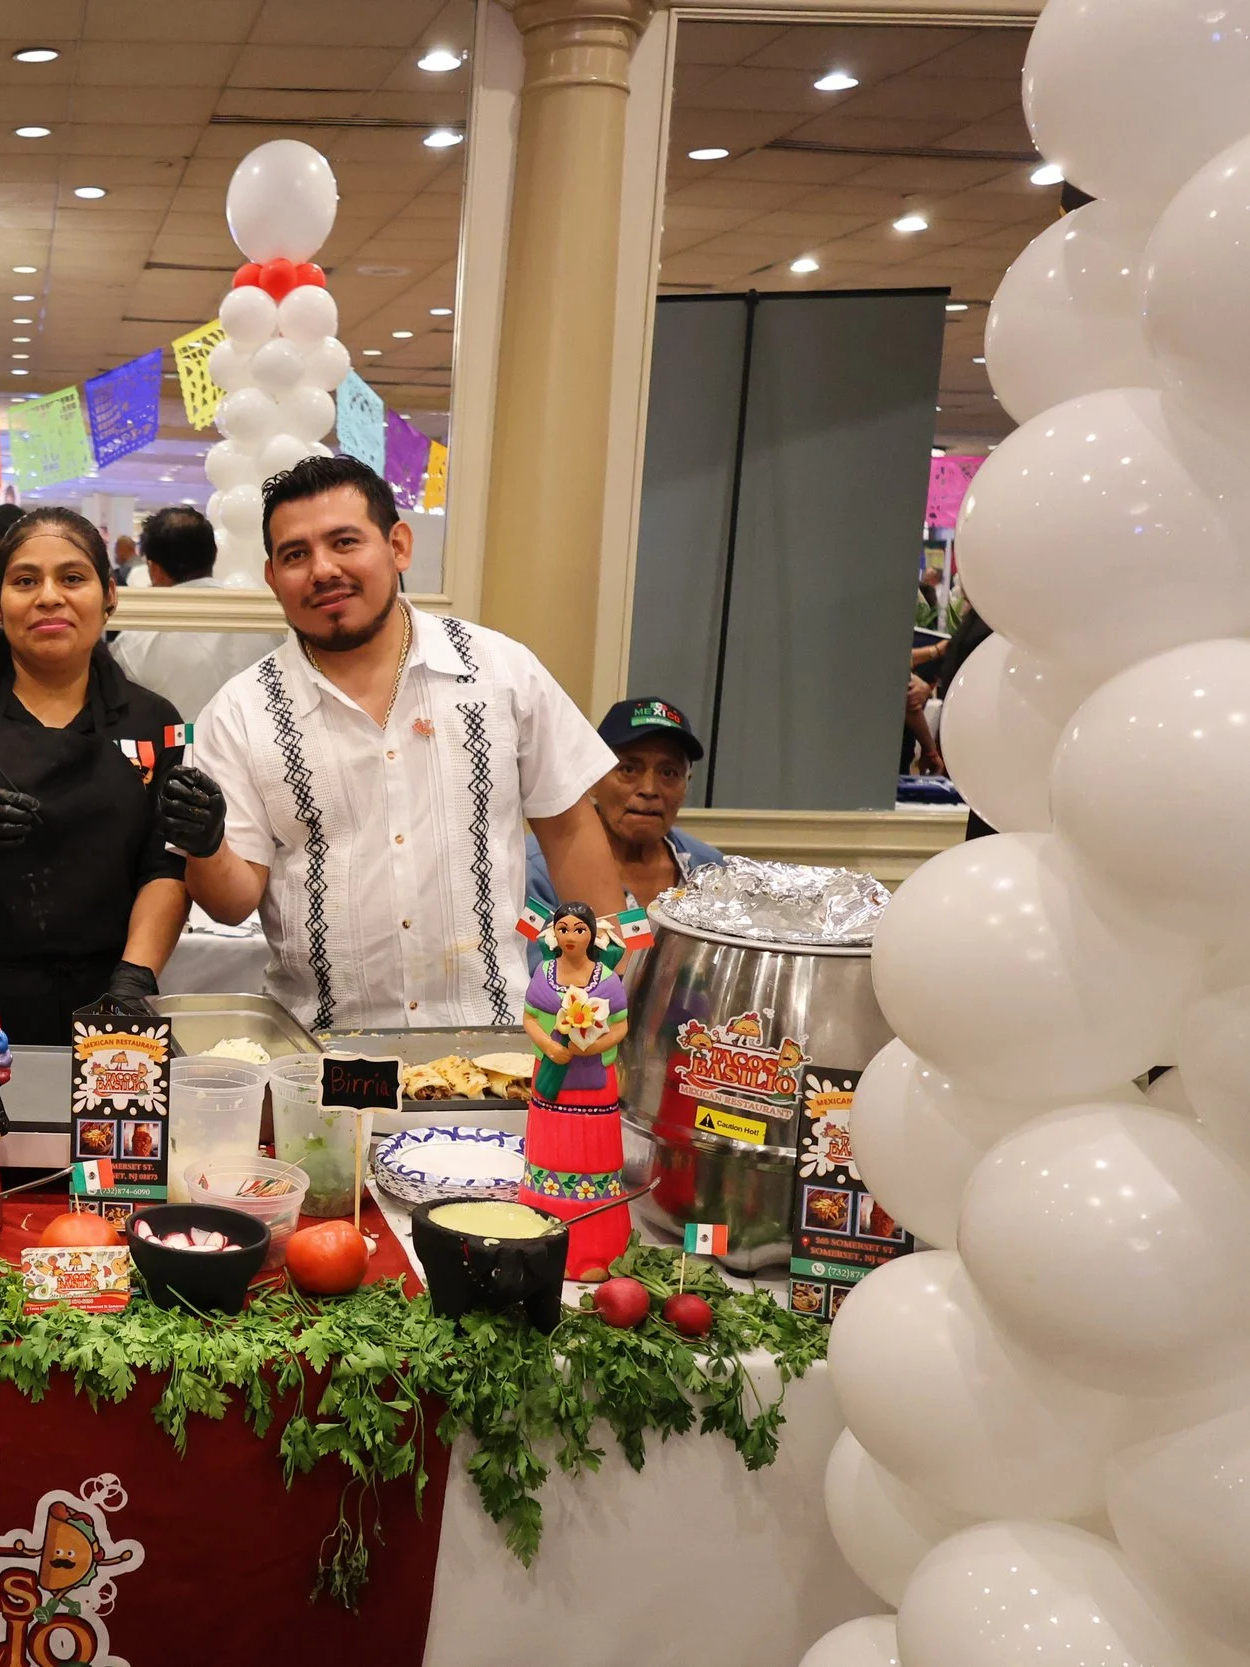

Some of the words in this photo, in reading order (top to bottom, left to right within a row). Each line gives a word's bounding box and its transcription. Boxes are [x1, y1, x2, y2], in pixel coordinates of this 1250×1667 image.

[634, 707, 681, 724] MEXICO
[83, 1039, 114, 1049] MEXICAN
[116, 1039, 160, 1052] RESTAURANT
[710, 1046, 779, 1076] TACOS
[105, 1072, 139, 1081] TACOS
[331, 1066, 391, 1097] Birria
[691, 1056, 797, 1095] BASILIO
[95, 1079, 148, 1092] BASILIO
[680, 1084, 722, 1103] MEXICAN
[724, 1097, 792, 1118] RESTAURANT
[816, 1098, 853, 1106] MEXICAN
[716, 1120, 742, 1133] Caution
[744, 1125, 760, 1136] Hot!
[830, 1238, 881, 1252] SOMERSET
